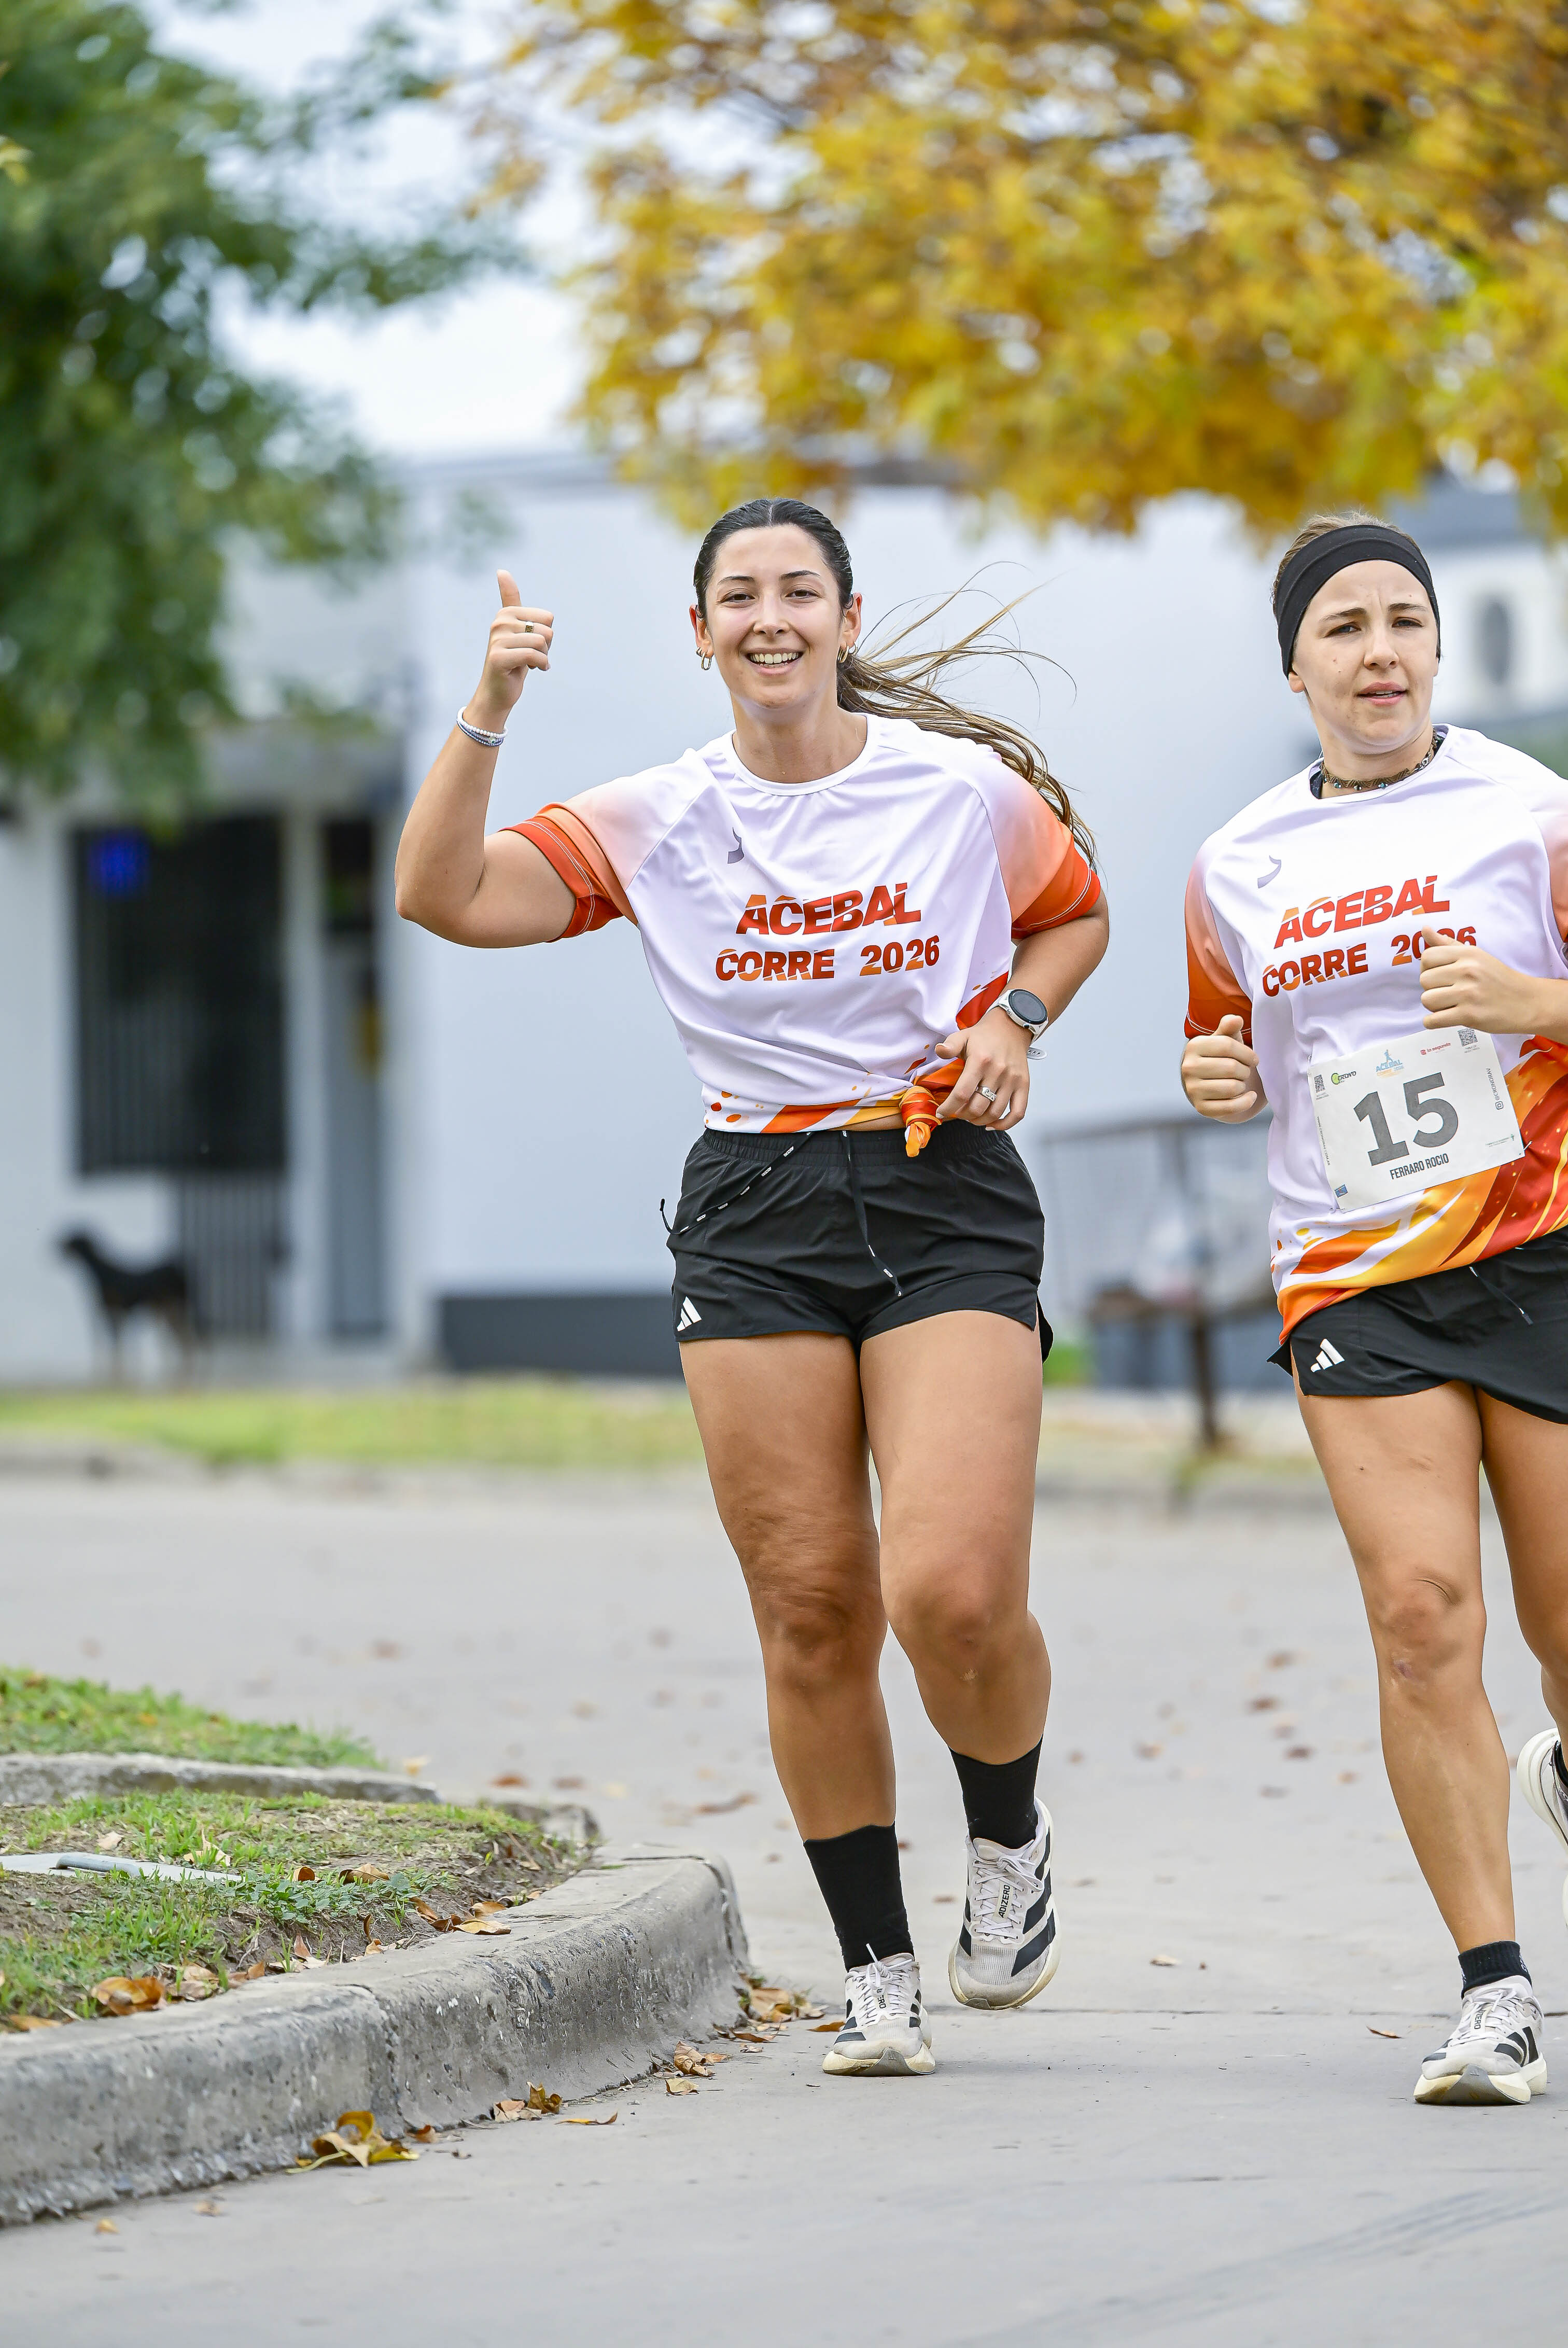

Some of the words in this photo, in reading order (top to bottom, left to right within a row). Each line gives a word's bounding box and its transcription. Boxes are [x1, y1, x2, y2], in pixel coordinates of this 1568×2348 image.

[736, 883, 921, 935] ACEBAL
[1273, 875, 1450, 949] ACEBAL
[716, 948, 835, 981] CORRE
[860, 935, 940, 976] 2026
[1262, 943, 1368, 997] CORRE
[1353, 1072, 1459, 1166] 15
[1390, 1161, 1425, 1179] FERRARO
[1425, 1153, 1449, 1169] ROCIO
[998, 1884, 1011, 1918] ADIZERO
